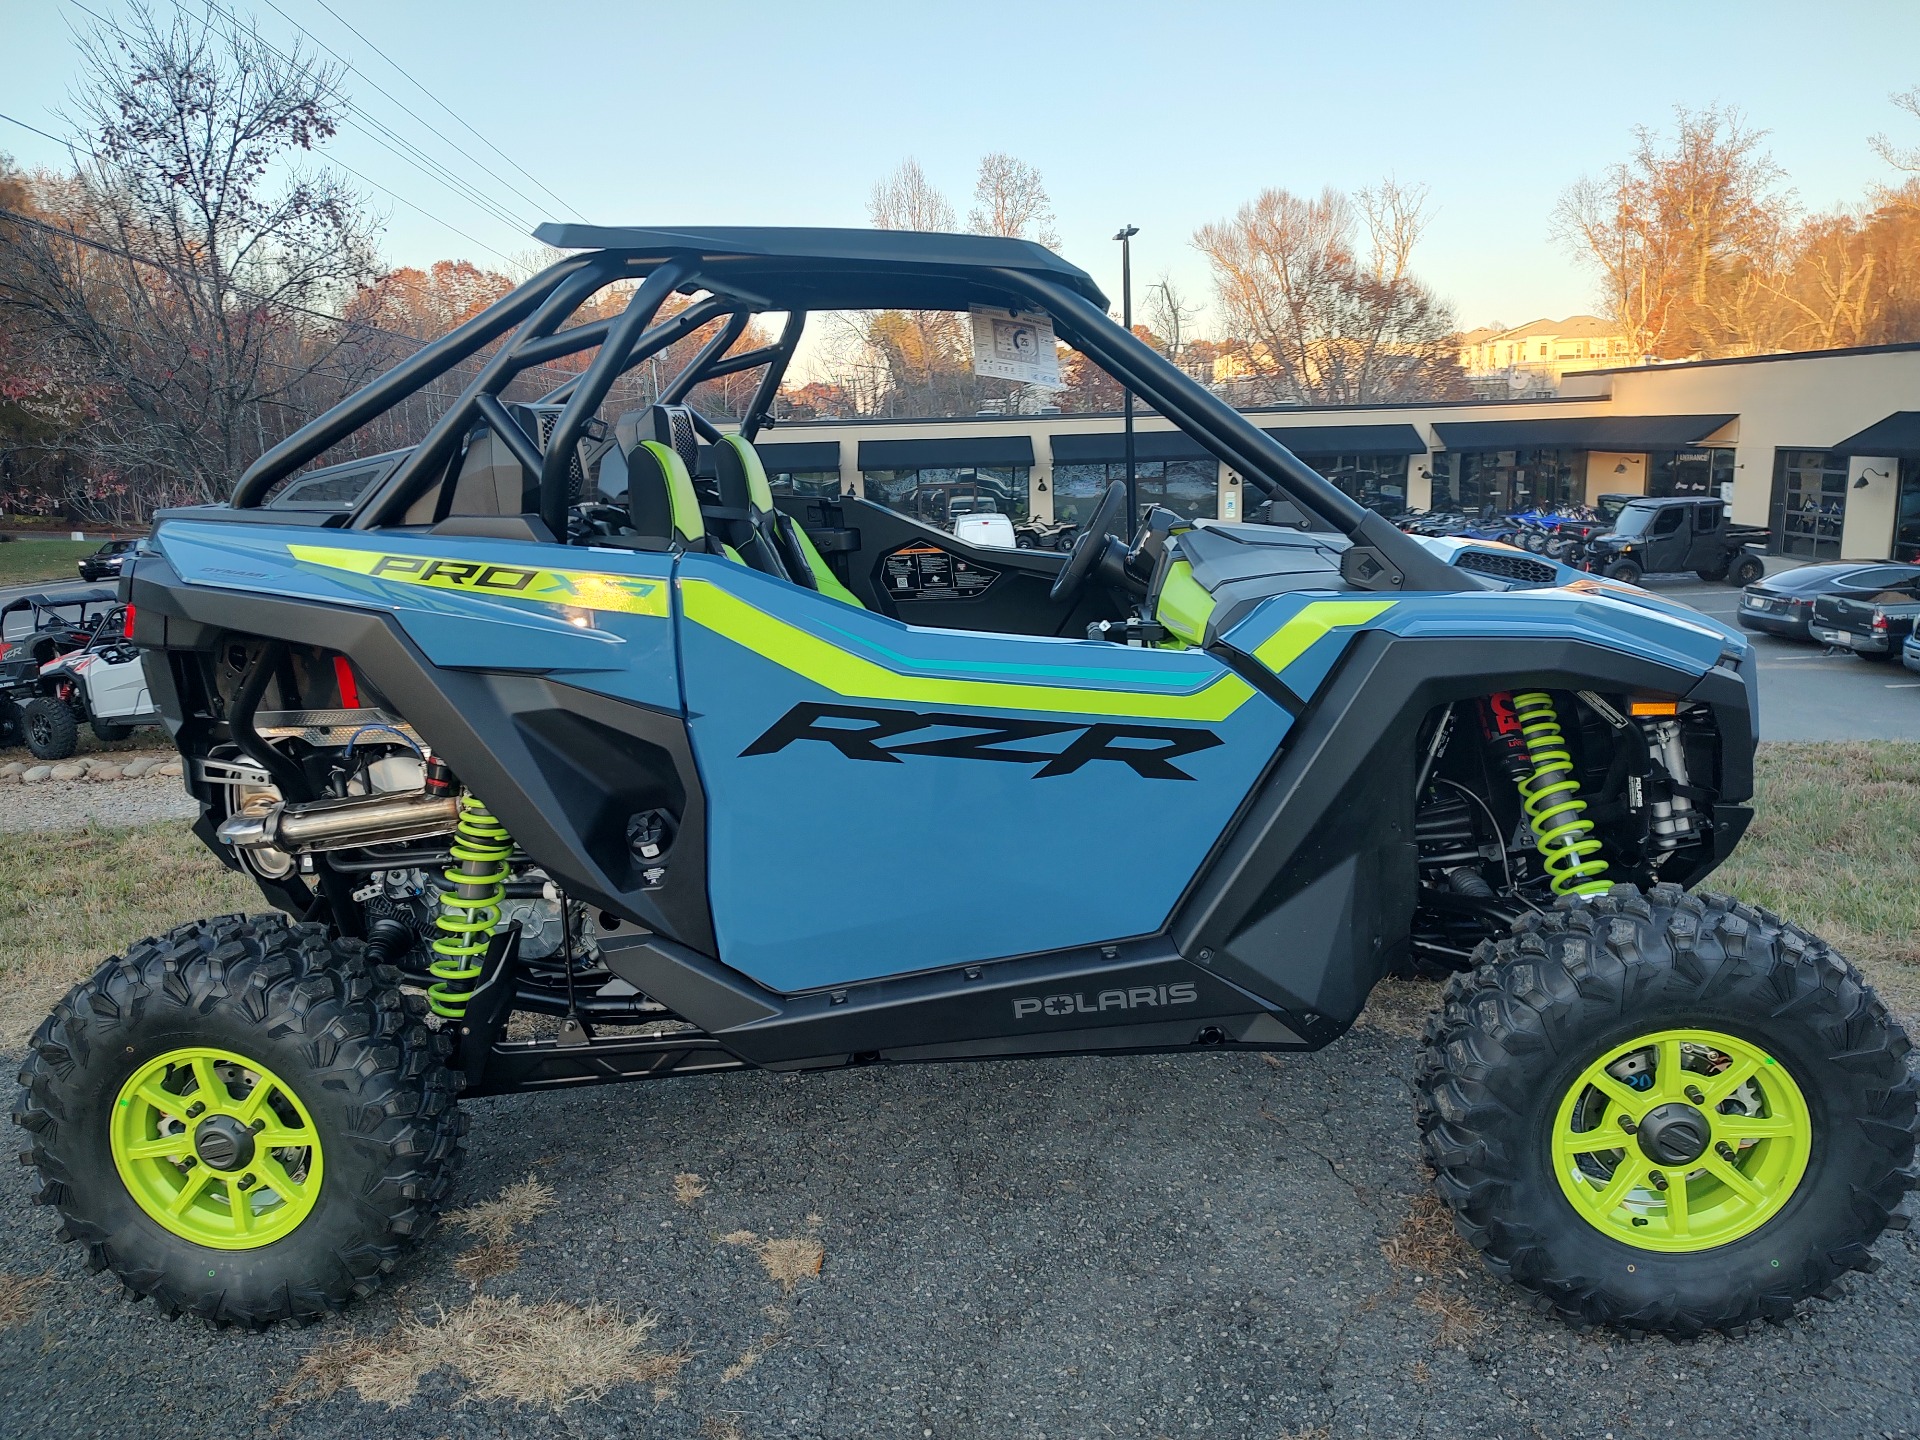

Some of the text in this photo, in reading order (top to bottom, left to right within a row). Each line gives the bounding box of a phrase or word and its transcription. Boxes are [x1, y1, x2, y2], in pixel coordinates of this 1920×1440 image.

[369, 555, 539, 591] PRO
[737, 701, 1226, 781] RZR
[1635, 777, 1643, 807] POLARIS
[1012, 982, 1198, 1019] POLARIS
